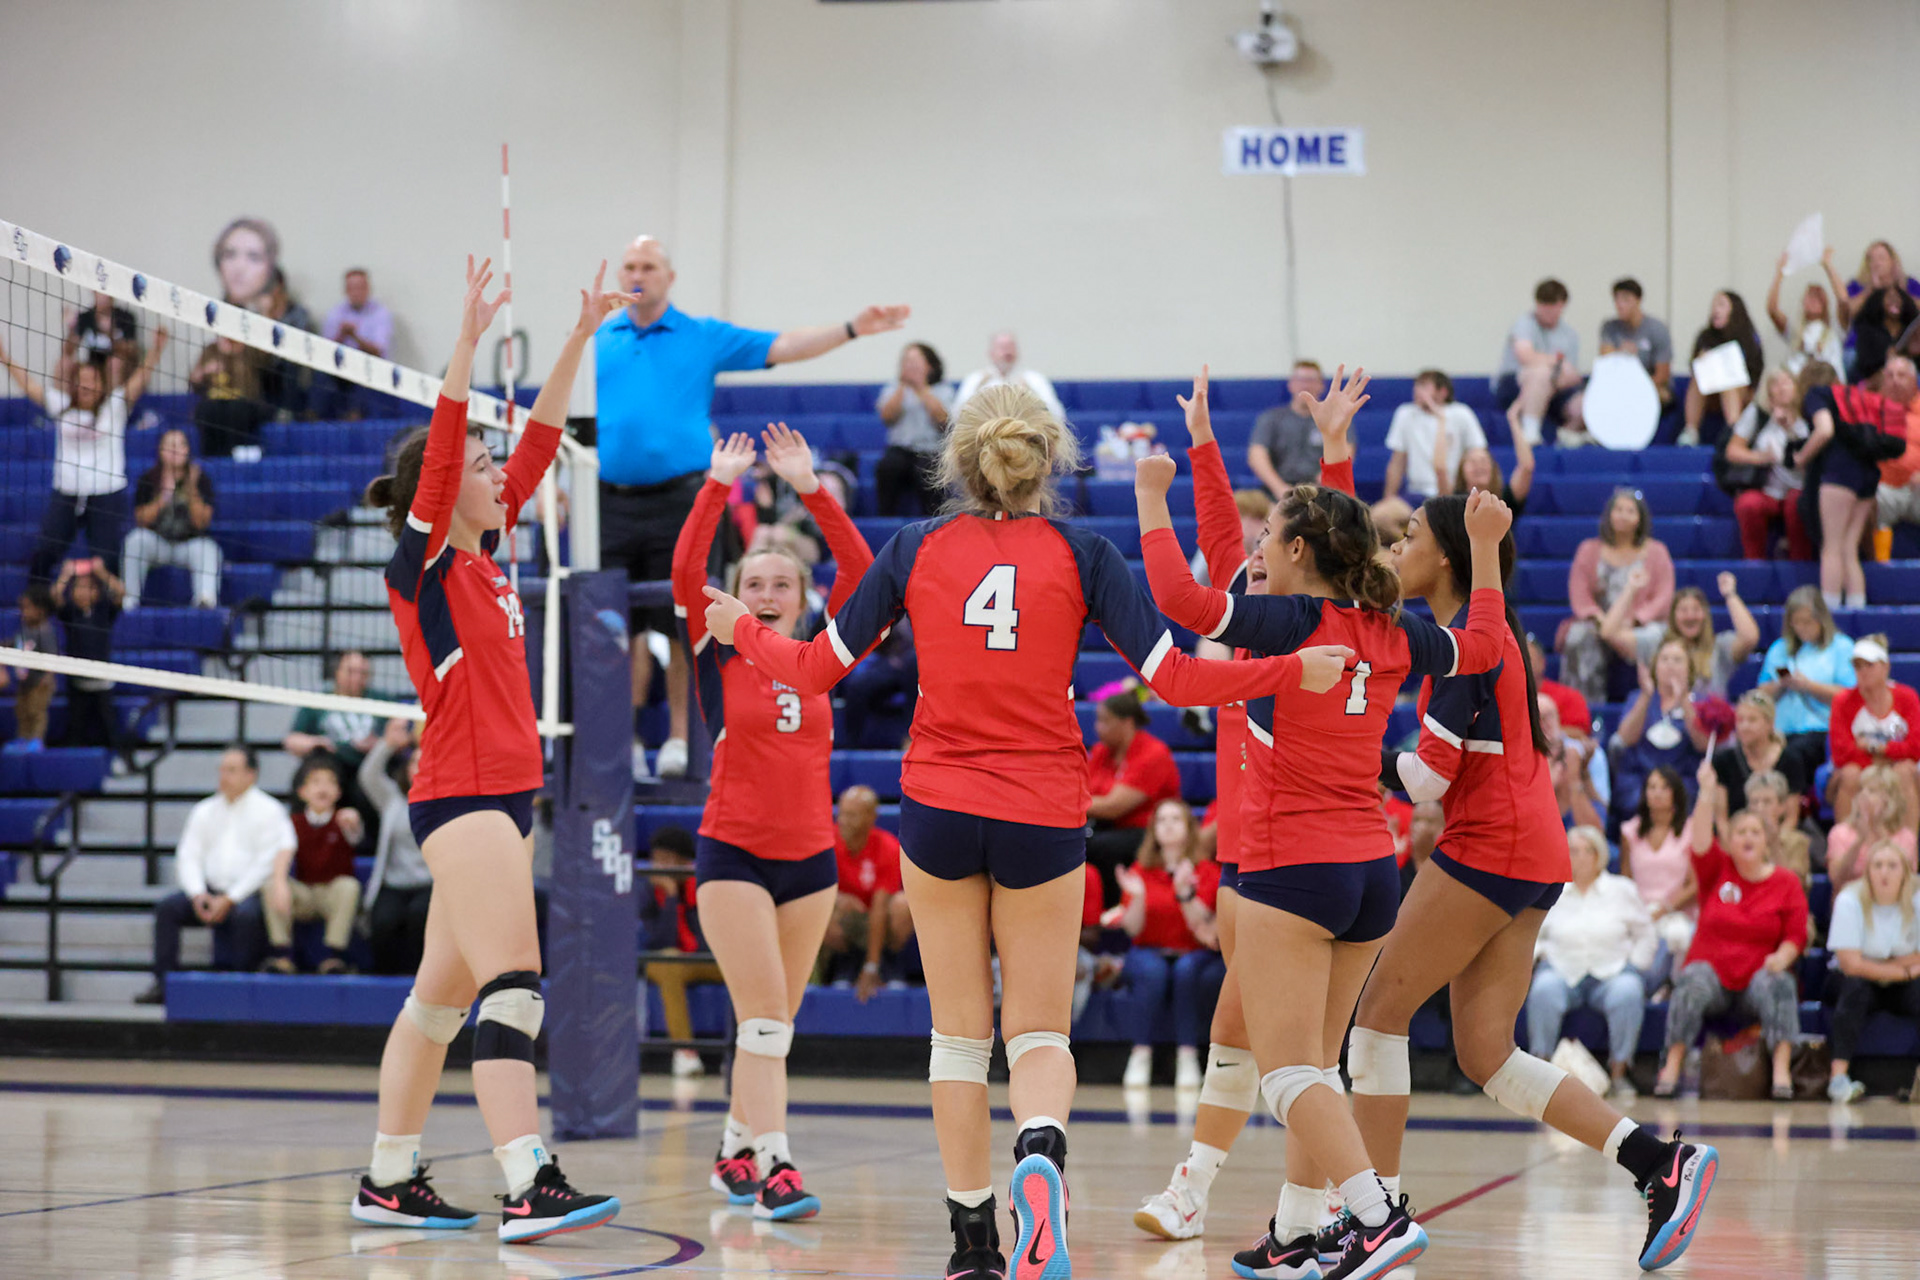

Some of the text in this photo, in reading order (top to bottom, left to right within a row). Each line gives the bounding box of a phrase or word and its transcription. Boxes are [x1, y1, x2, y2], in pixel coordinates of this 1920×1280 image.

[1241, 135, 1346, 166] HOME
[963, 564, 1019, 651] 4
[1345, 660, 1372, 715] 1
[776, 692, 802, 733] 3
